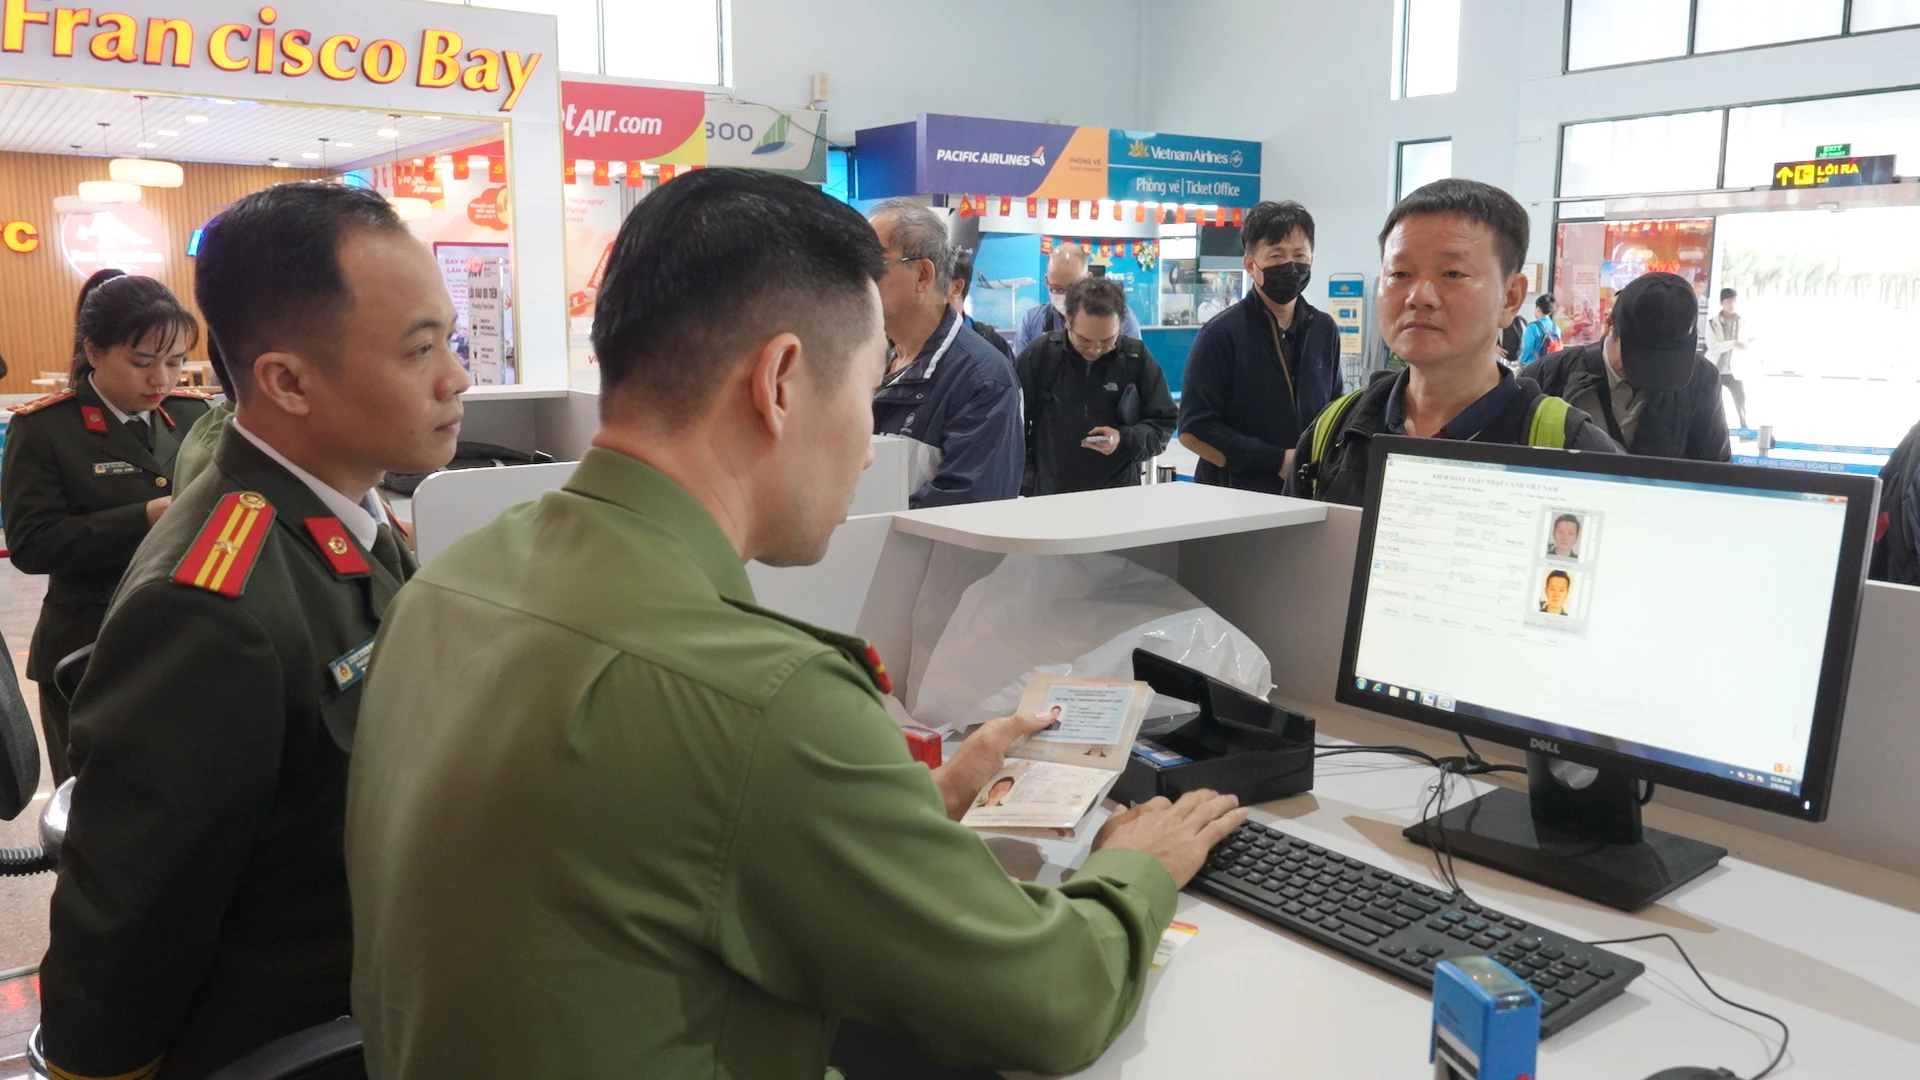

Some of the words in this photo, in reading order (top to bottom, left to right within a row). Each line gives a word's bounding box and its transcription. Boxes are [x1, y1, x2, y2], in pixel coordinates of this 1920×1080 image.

[416, 28, 542, 111] Bay
[936, 148, 980, 163] PACIFIC
[981, 151, 1030, 167] AIRLINES
[1840, 163, 1859, 175] RA
[1136, 176, 1166, 197] Phòng
[1186, 179, 1212, 196] Ticket
[1214, 181, 1240, 197] Office
[1529, 737, 1560, 754] DELL
